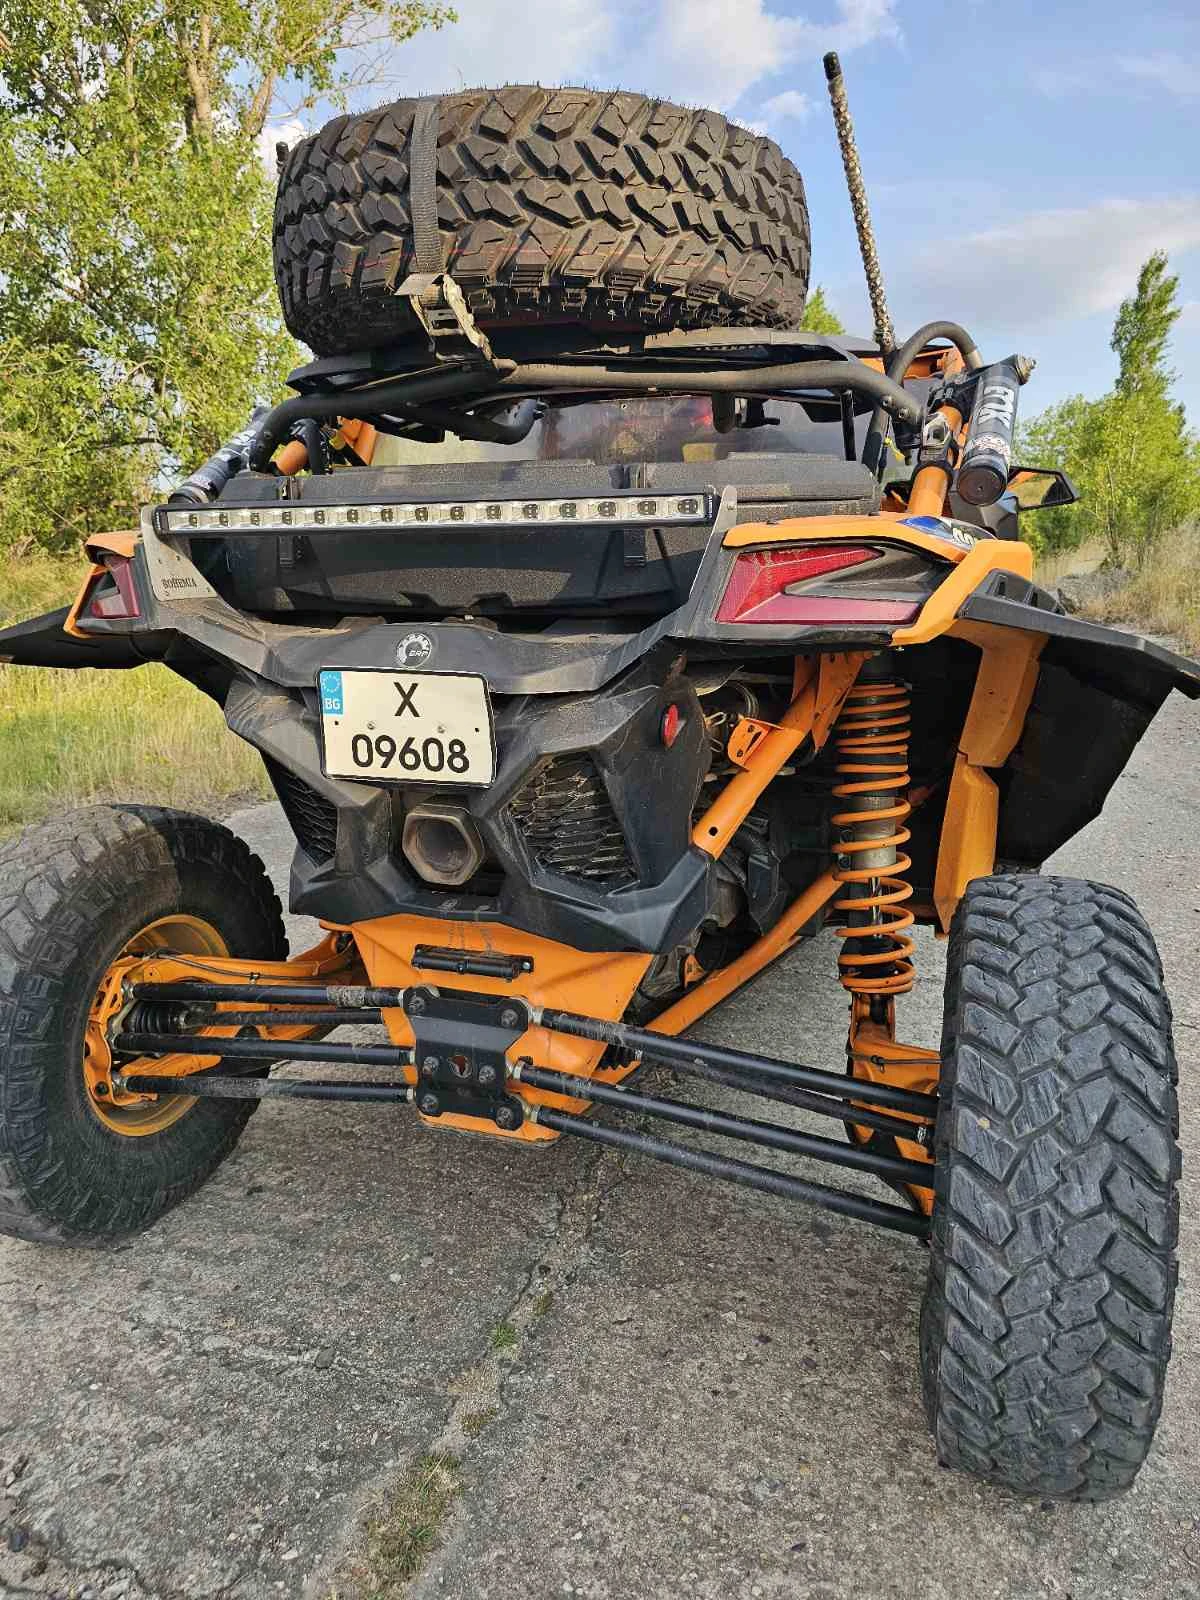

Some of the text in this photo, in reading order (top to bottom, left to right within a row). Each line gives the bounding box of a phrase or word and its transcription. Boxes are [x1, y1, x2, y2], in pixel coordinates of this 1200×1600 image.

[324, 697, 341, 710] BG
[393, 681, 420, 717] X
[351, 733, 470, 774] 09608
